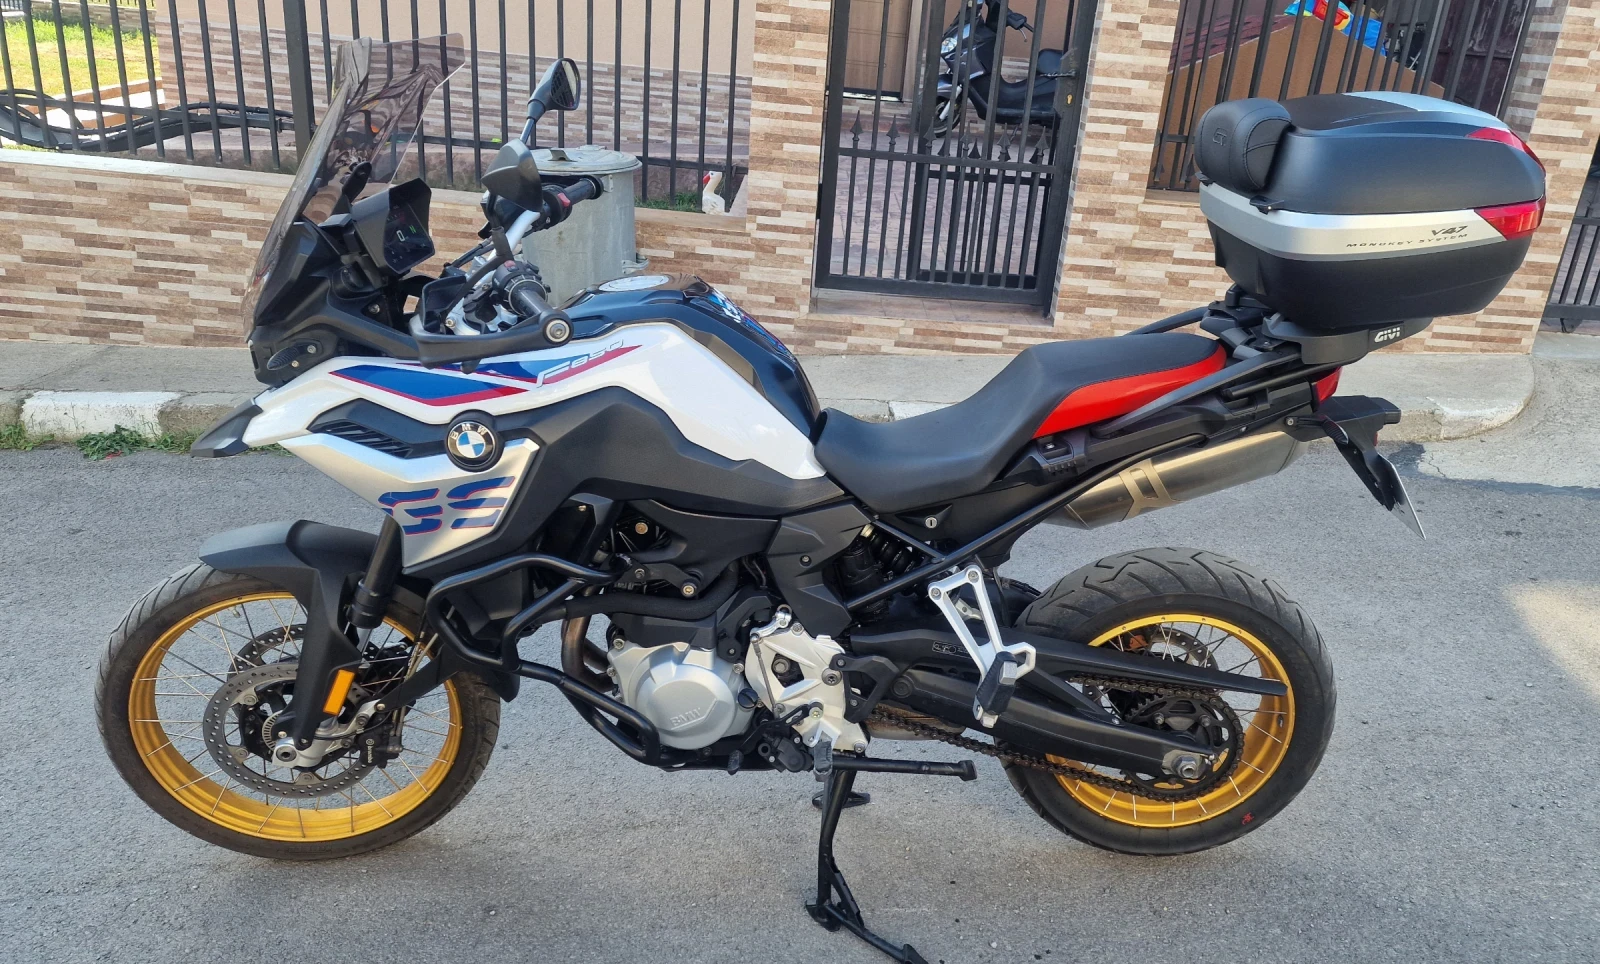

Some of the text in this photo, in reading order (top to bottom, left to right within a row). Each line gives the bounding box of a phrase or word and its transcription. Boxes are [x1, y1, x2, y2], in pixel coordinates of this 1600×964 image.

[1431, 225, 1468, 236] V47
[1346, 233, 1468, 248] MONOKEY SYSTEM
[1374, 326, 1401, 343] GIVI
[449, 423, 488, 440] BMW
[670, 707, 701, 727] BMW
